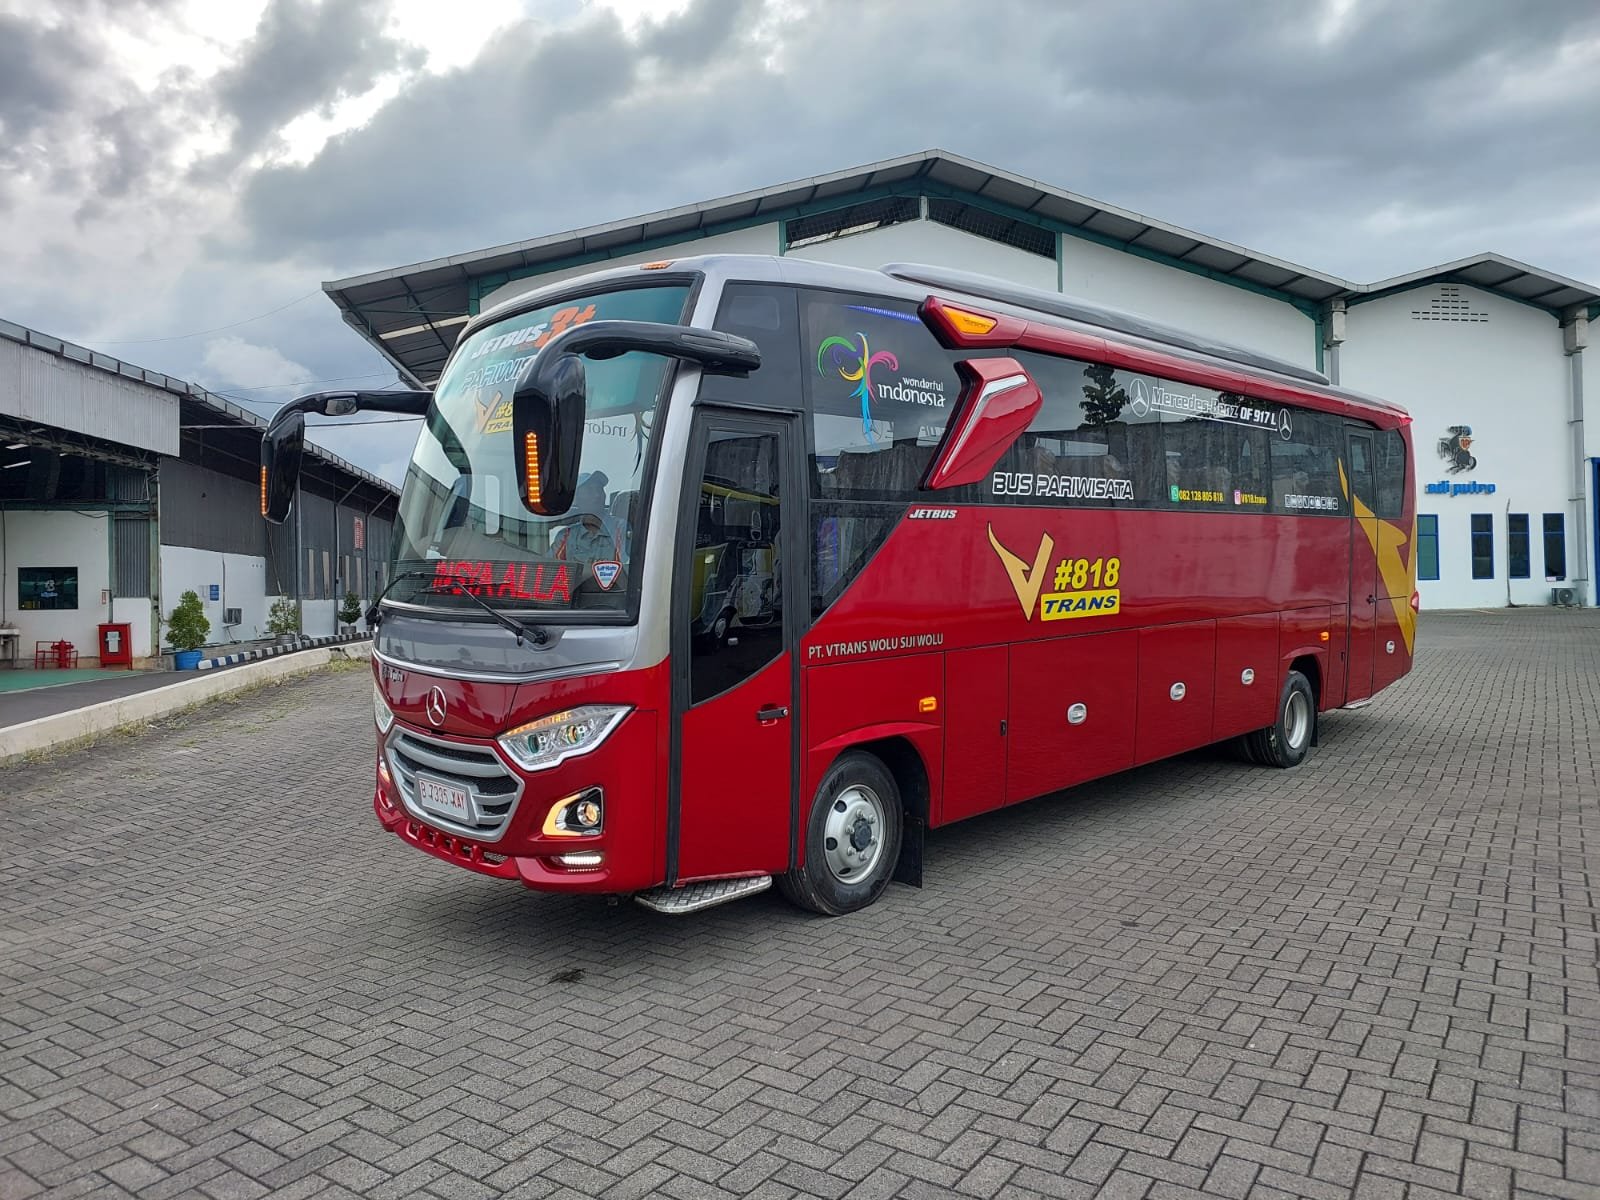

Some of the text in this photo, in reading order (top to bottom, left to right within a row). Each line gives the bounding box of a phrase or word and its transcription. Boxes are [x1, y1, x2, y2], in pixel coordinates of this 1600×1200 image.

[471, 323, 548, 359] JETBUS
[902, 376, 944, 392] wonderful
[1151, 386, 1277, 426] Mercedes-Benz OF 917 L
[992, 472, 1134, 500] BUS PARIWISATA
[909, 509, 958, 519] JETBUS
[1054, 557, 1121, 591] #818
[1044, 595, 1118, 614] TRANS
[808, 633, 944, 659] PT. VTRANS WOLU SIJI WOLU
[421, 782, 426, 798] B
